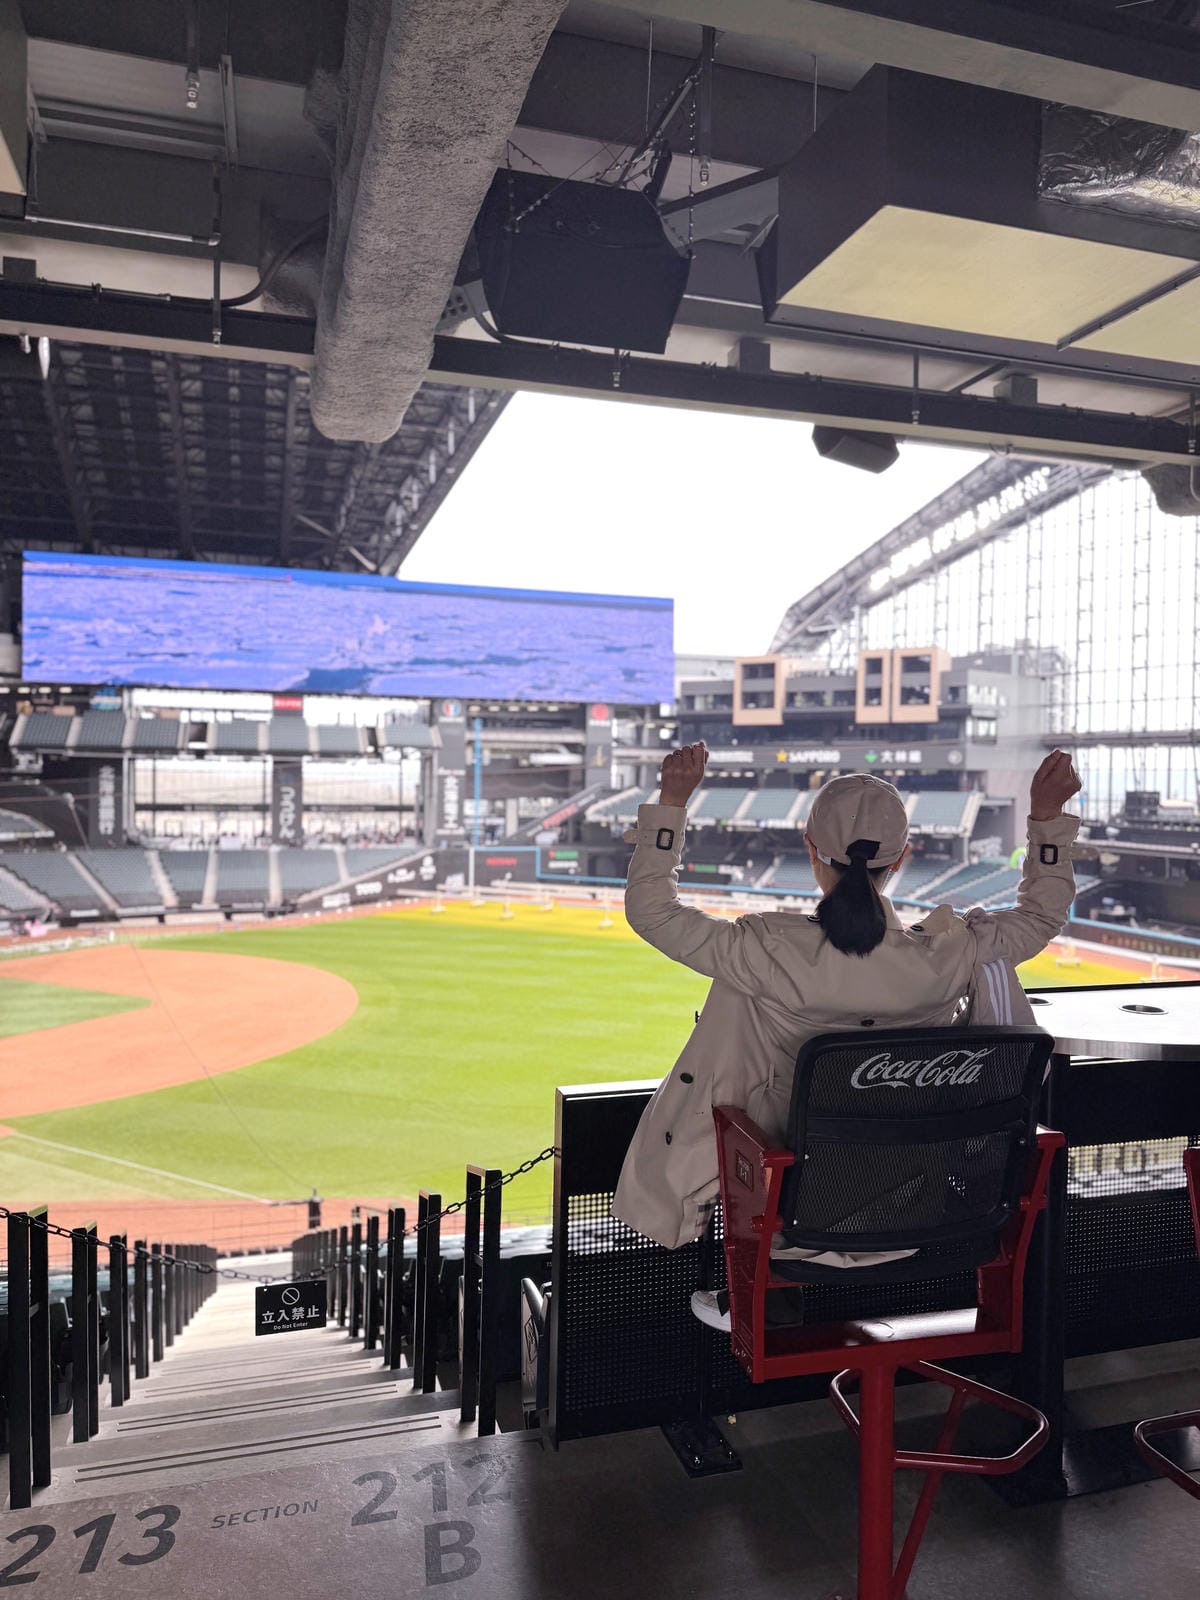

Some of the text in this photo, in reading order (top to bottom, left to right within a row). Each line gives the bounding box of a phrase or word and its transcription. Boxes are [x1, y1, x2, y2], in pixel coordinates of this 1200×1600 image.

[850, 1046, 997, 1089] Coca-Cola
[261, 1304, 320, 1324] 立入禁止
[0, 1453, 511, 1587] 213 SECTION 212
[424, 1520, 482, 1587] B
